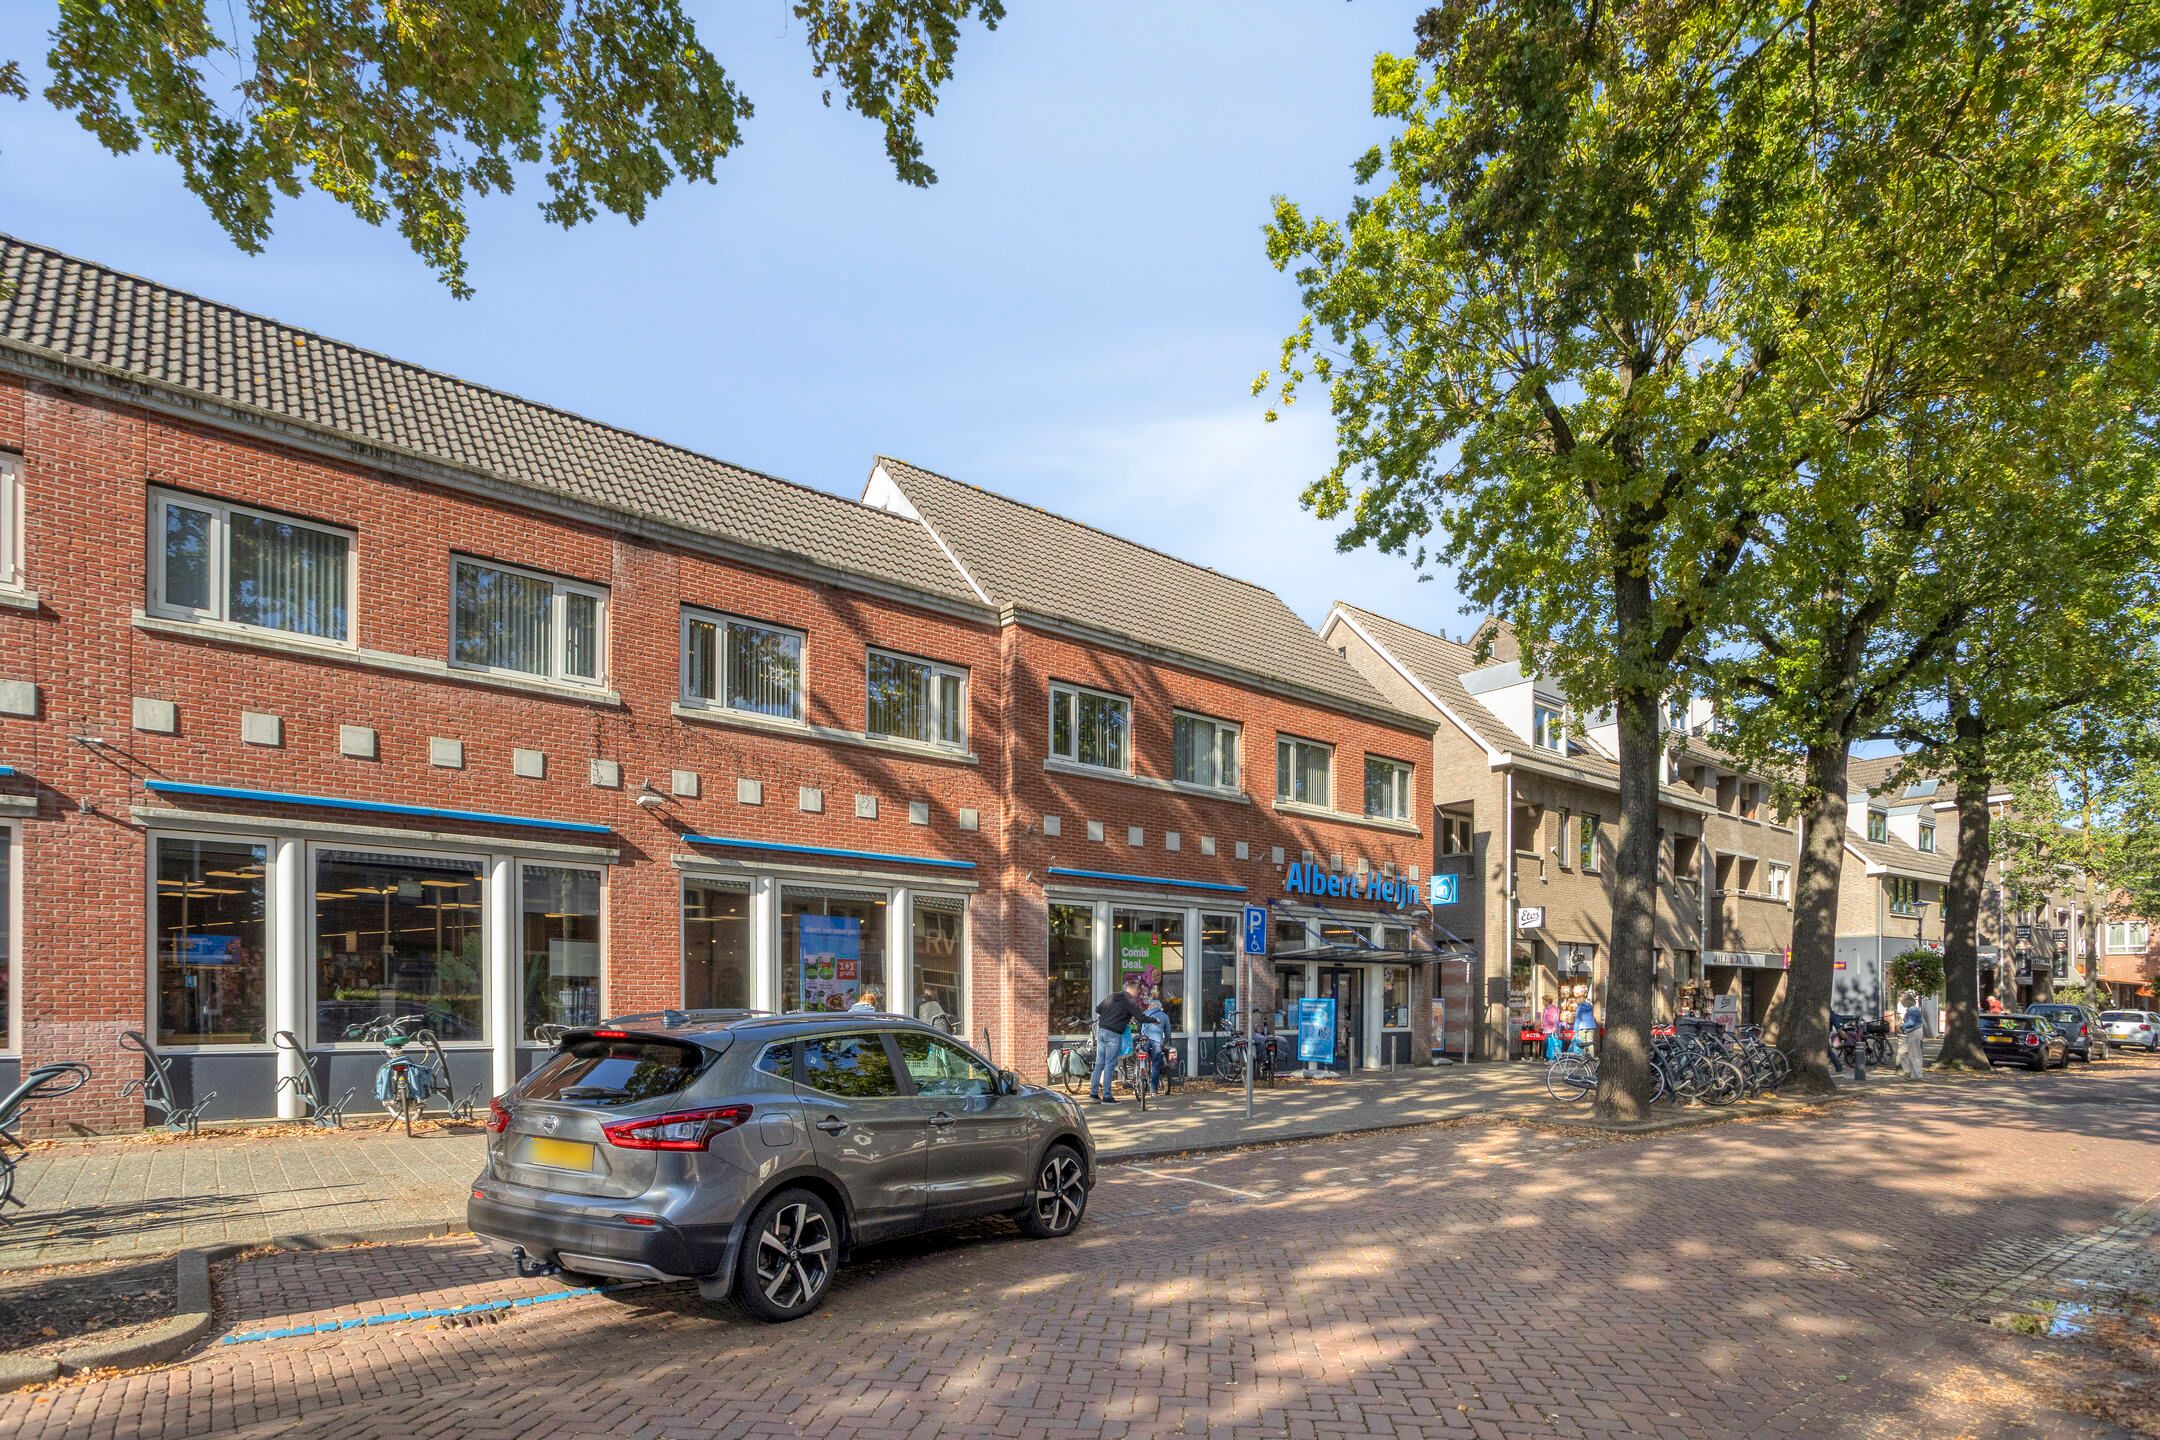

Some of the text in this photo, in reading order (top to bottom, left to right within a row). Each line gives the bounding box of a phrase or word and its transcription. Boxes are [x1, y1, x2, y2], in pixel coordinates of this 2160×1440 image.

[1286, 863, 1419, 910] Albert Heijn
[1521, 909, 1540, 922] Etos
[1250, 911, 1262, 934] P
[1122, 947, 1149, 958] Combi
[839, 962, 855, 971] 1+1
[1122, 959, 1143, 969] Deal.
